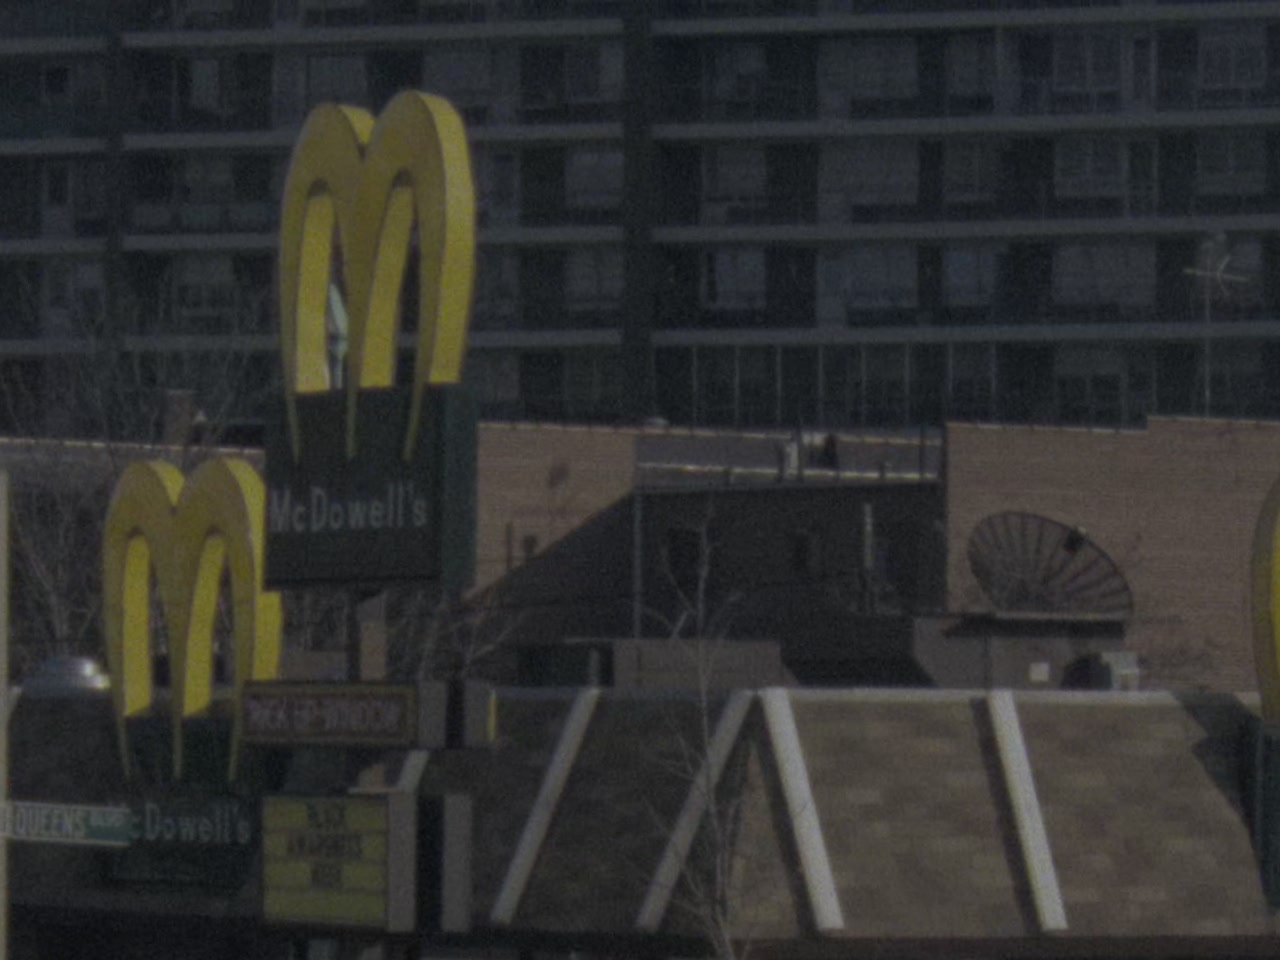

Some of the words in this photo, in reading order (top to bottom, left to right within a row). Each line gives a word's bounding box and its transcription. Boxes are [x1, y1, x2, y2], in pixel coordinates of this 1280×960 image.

[269, 480, 429, 534] McDowell's
[15, 806, 86, 838] QUEENS
[128, 802, 252, 845] cDowell's
